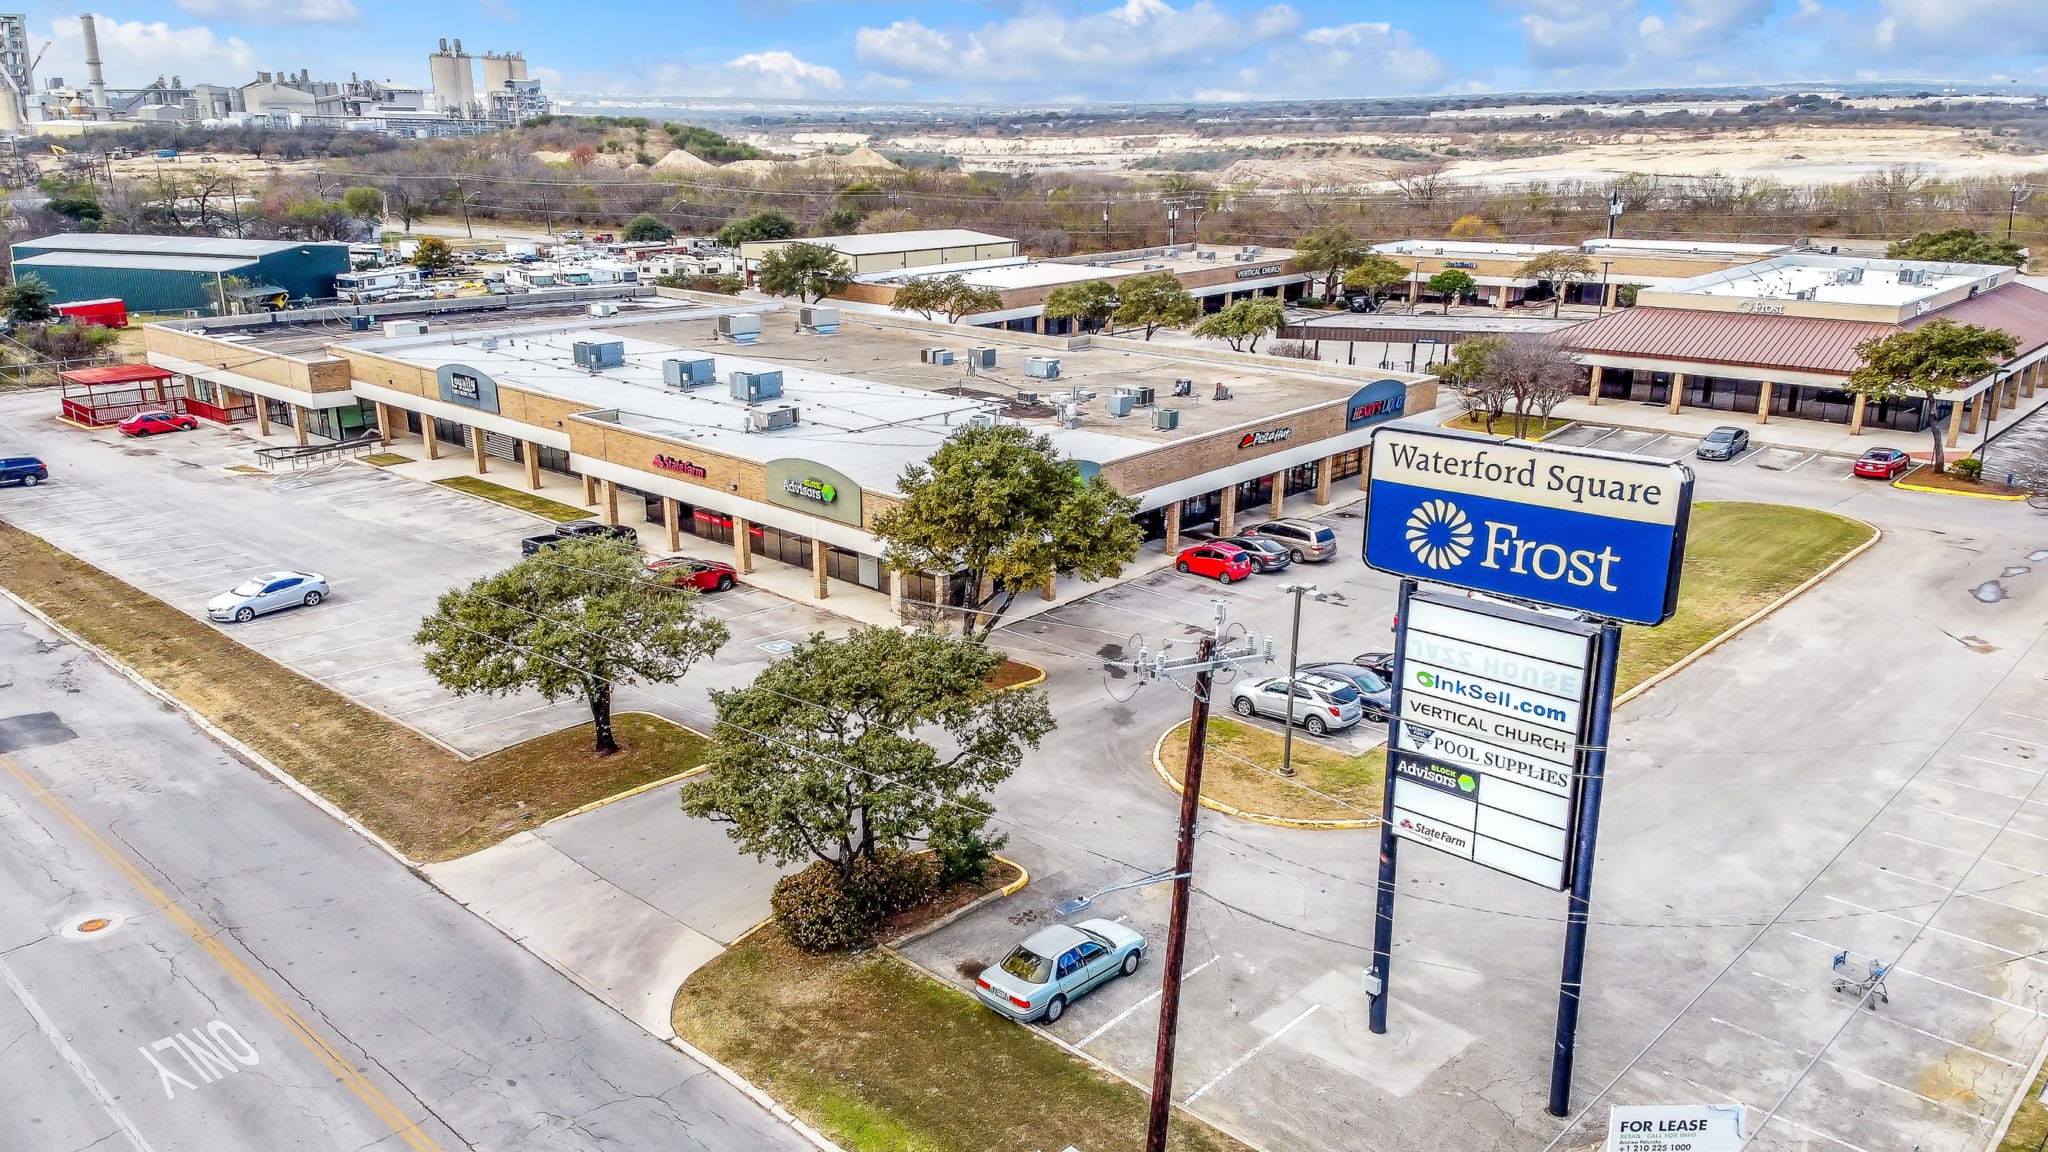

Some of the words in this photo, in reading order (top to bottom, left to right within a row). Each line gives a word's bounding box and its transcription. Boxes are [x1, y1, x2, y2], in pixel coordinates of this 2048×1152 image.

[1753, 302, 1785, 314] Frost
[784, 479, 822, 500] Advisors
[1389, 442, 1536, 488] Waterford
[1547, 464, 1662, 506] Square
[1480, 520, 1622, 593] Frost
[1434, 674, 1567, 723] InkSell.com
[1410, 699, 1488, 733] VERTICAL
[1494, 723, 1567, 754] CHURCH
[1397, 760, 1457, 789] Advisors
[1431, 764, 1457, 778] BLOCK
[1434, 736, 1480, 763] POOL
[1484, 751, 1569, 788] SUPPLIES
[138, 1020, 260, 1100] ONLY
[1620, 1120, 1653, 1133] FOR
[1658, 1119, 1708, 1132] LEASE
[1633, 1144, 1650, 1152] 210
[1652, 1144, 1668, 1152] 225
[1671, 1143, 1692, 1151] 1000
